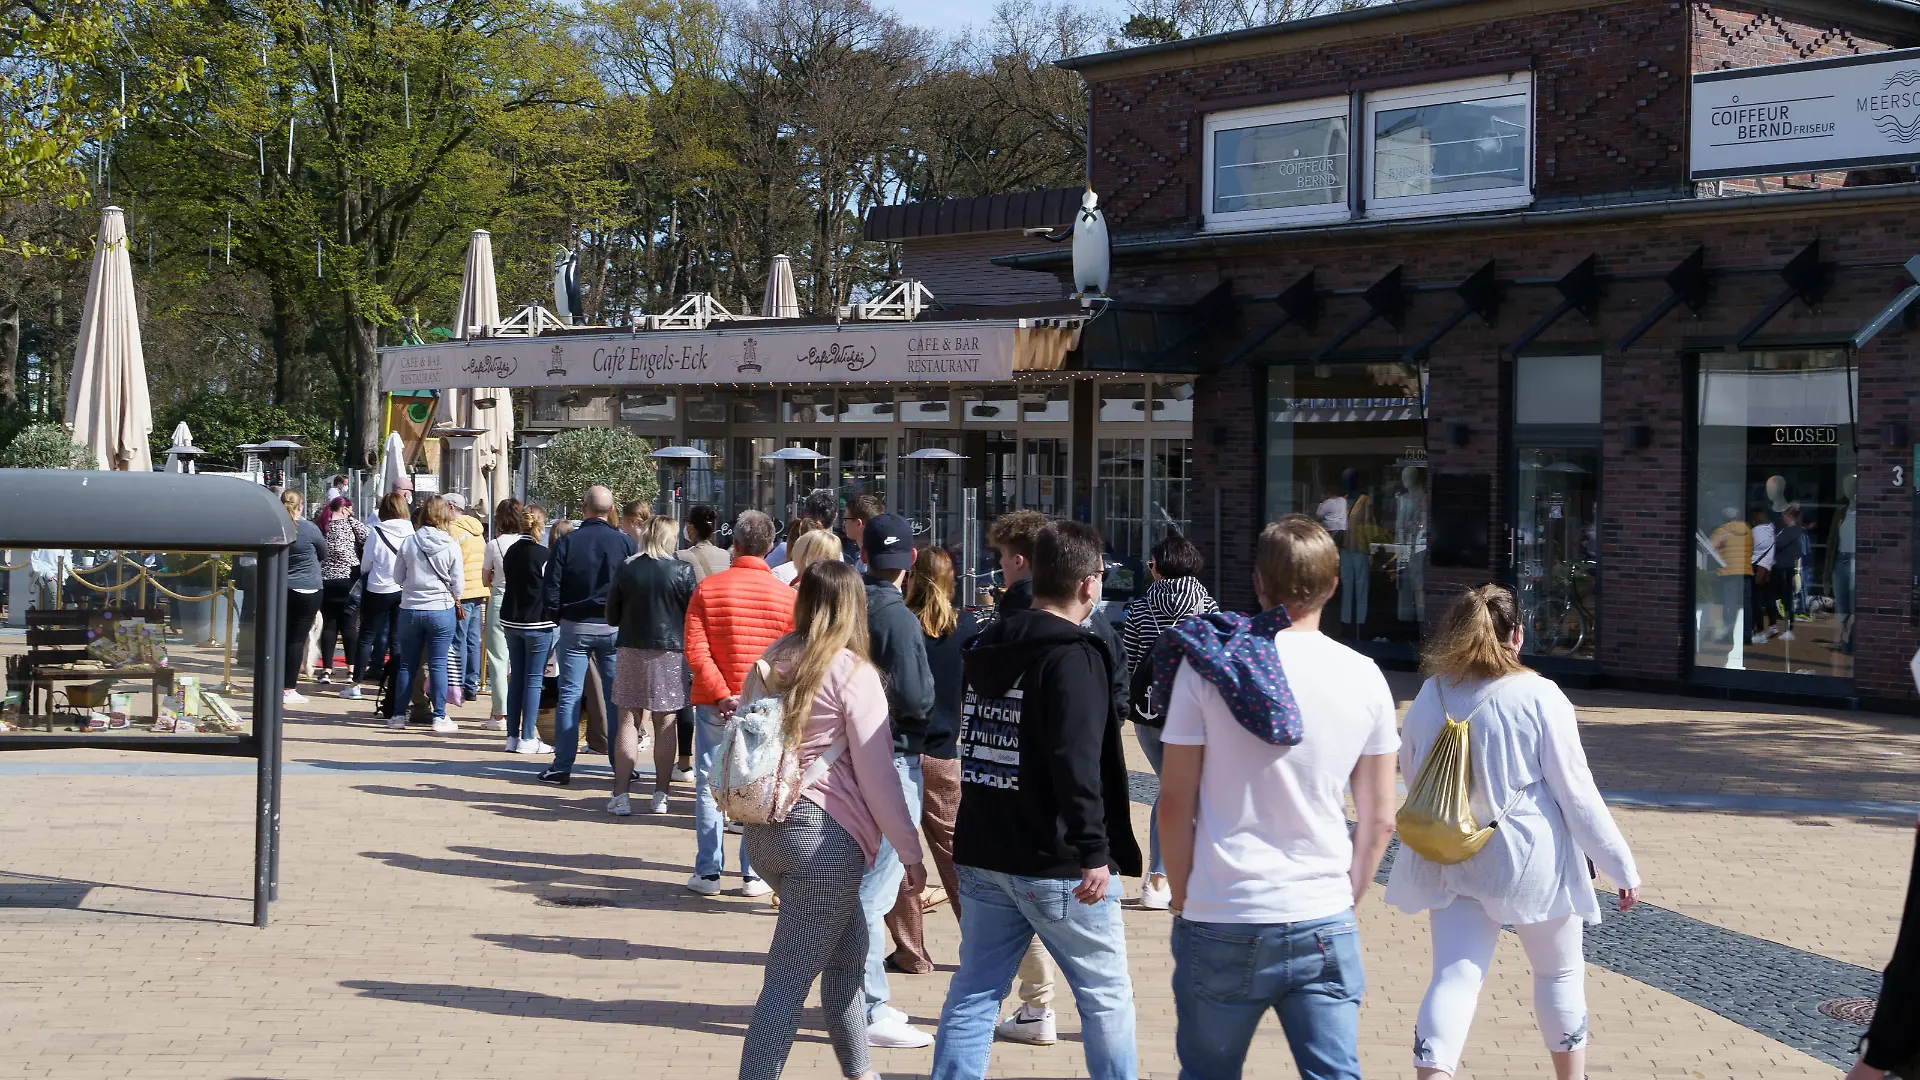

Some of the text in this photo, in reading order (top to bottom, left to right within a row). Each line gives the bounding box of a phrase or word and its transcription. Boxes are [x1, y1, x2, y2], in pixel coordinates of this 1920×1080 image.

[1711, 105, 1789, 126] COIFFEUR
[1738, 121, 1835, 139] BERND FRISEUR
[1279, 159, 1334, 176] COIFFEUR
[1297, 174, 1336, 188] BERND
[942, 337, 951, 351] &
[955, 336, 979, 350] BAR
[593, 344, 708, 379] Café Engels-Eck
[908, 358, 980, 373] RESTAURANT
[1775, 428, 1836, 443] CLOSED
[1892, 465, 1904, 487] 3
[966, 692, 978, 704] EIN
[977, 697, 1022, 724] VEREIN
